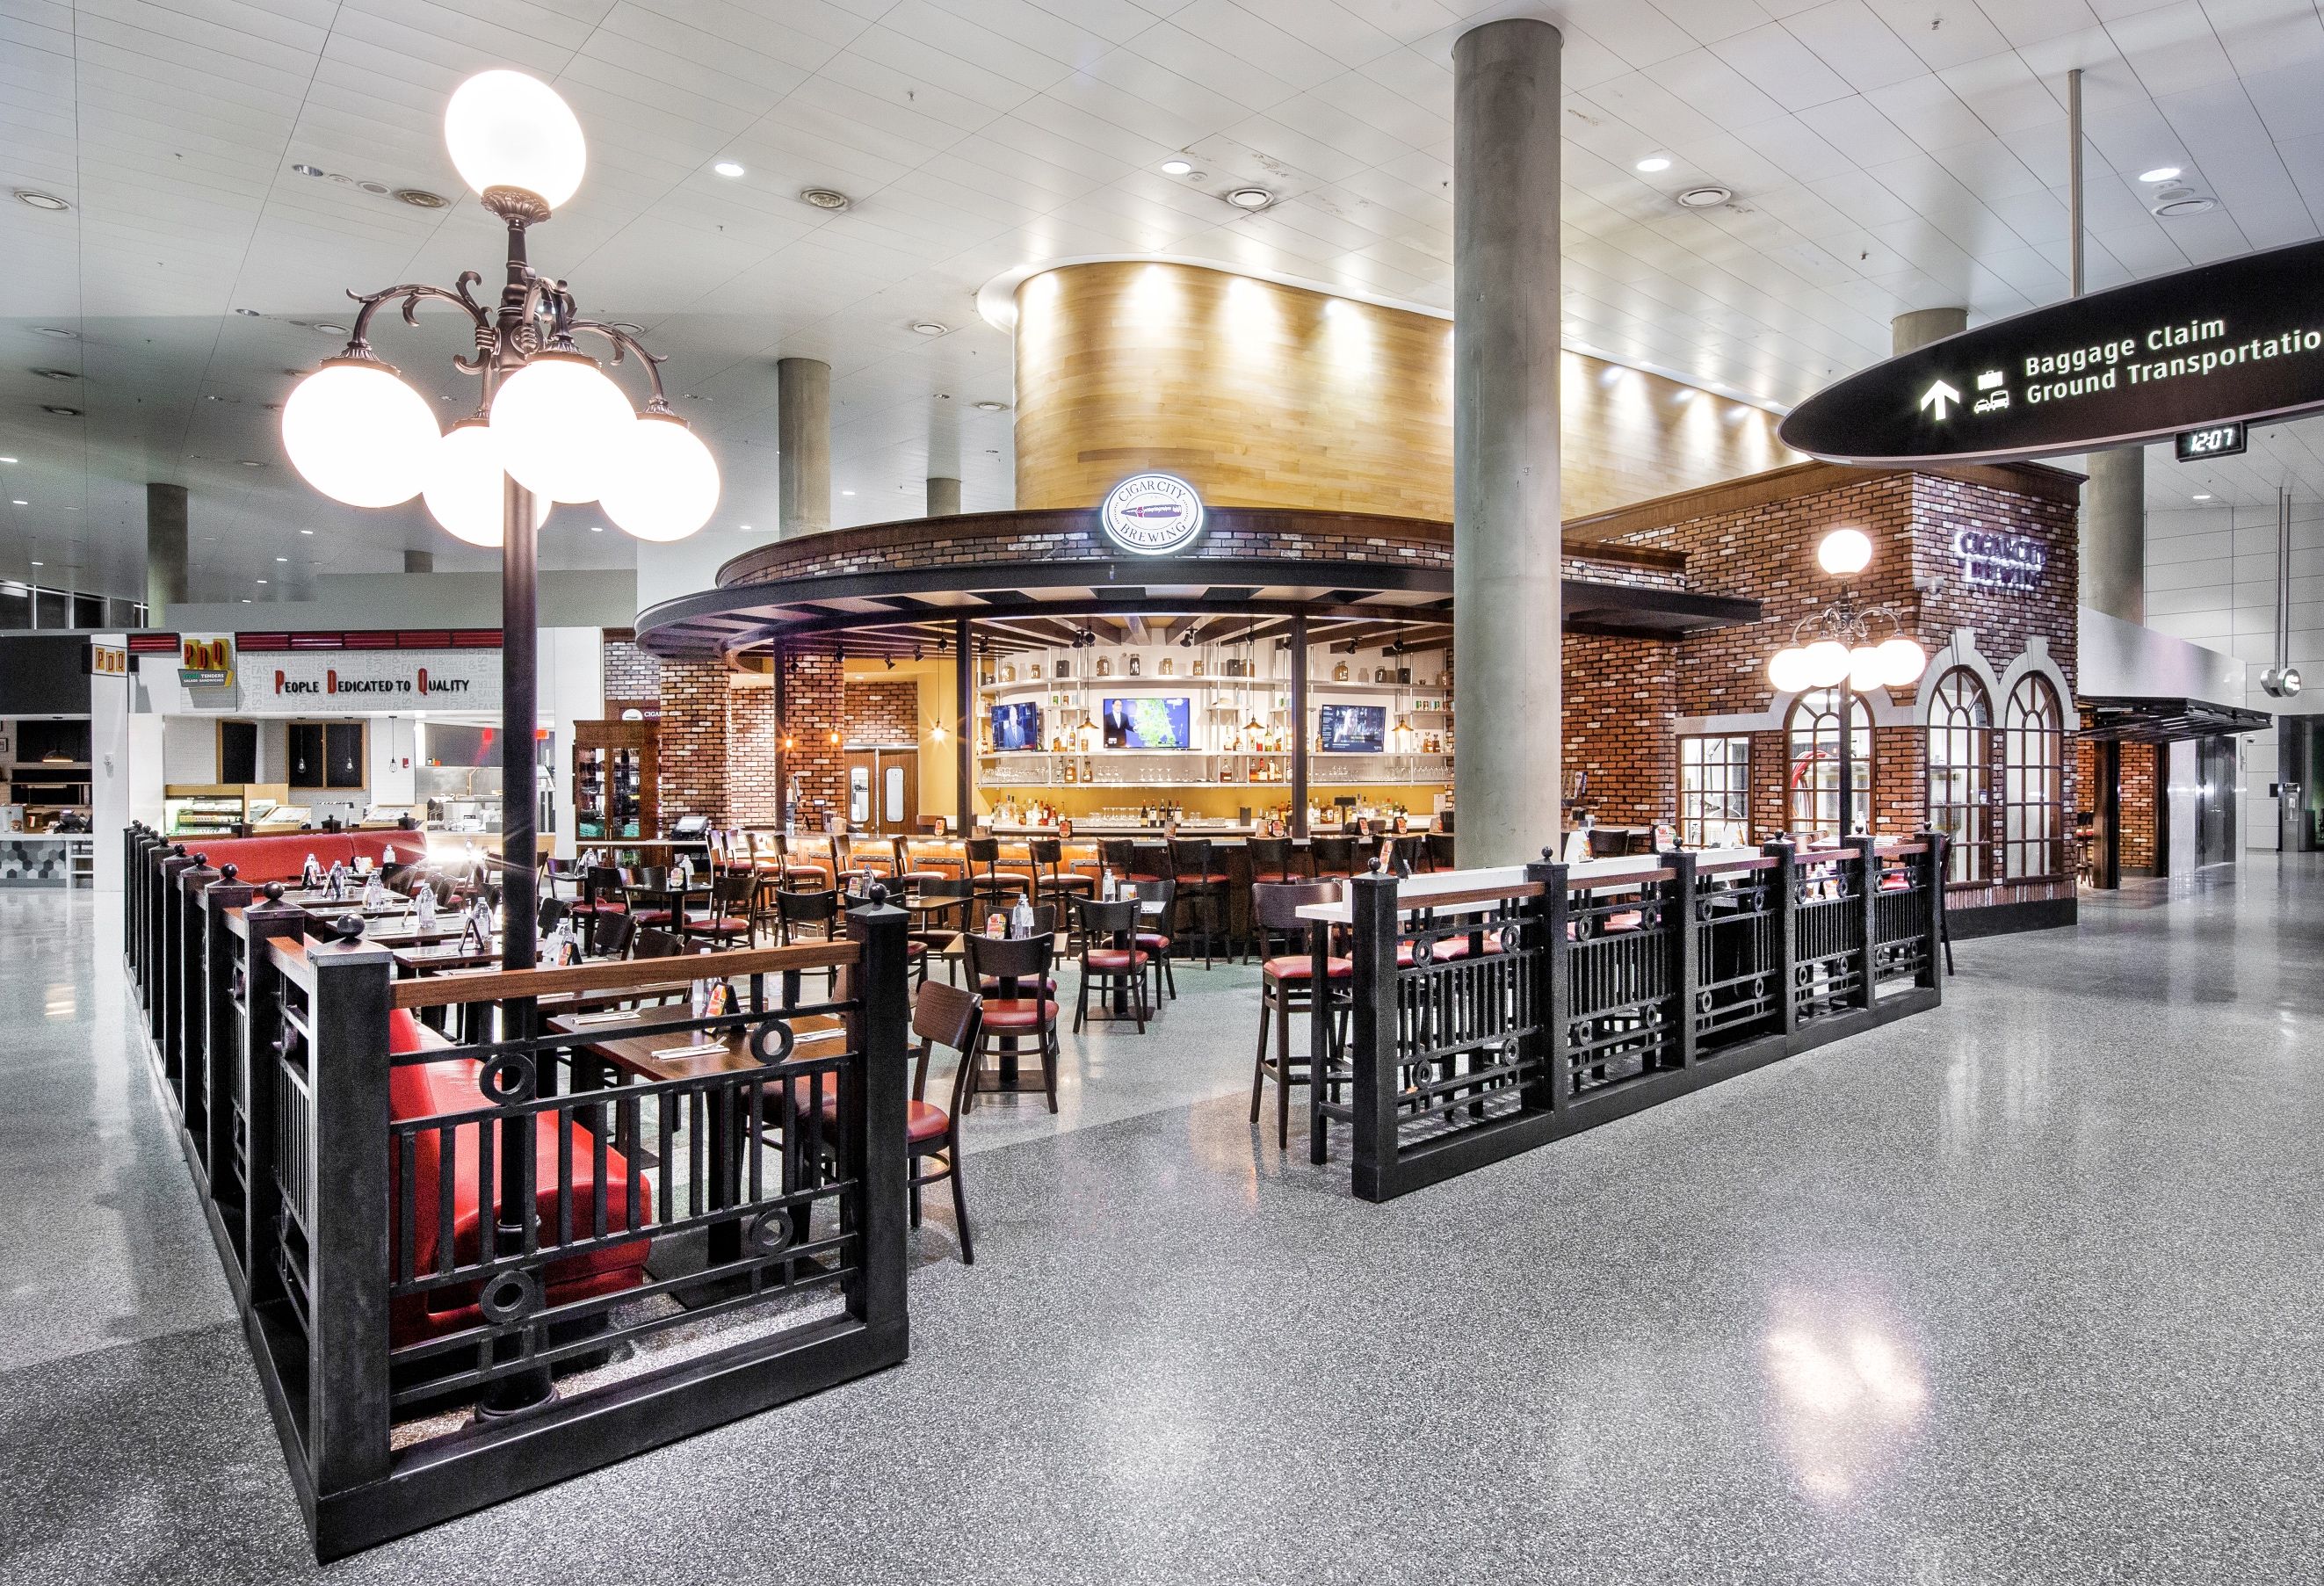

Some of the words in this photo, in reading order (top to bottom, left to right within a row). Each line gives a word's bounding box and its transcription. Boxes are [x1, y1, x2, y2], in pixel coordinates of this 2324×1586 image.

[2024, 339, 2135, 378] Baggage
[2147, 319, 2226, 351] Claim
[2026, 369, 2117, 404] Ground
[2127, 330, 2321, 384] Transportatio
[2190, 428, 2234, 452] 12:07
[1119, 481, 1155, 502] CIGAR
[1156, 482, 1186, 499] CITY
[1120, 522, 1186, 543] BREWING
[98, 650, 124, 671] PDQ
[185, 641, 223, 669] PDQ
[274, 670, 319, 694] PEOPLE
[327, 670, 394, 693] DEDICATED
[395, 680, 411, 692] TO
[417, 668, 469, 696] QUALITY
